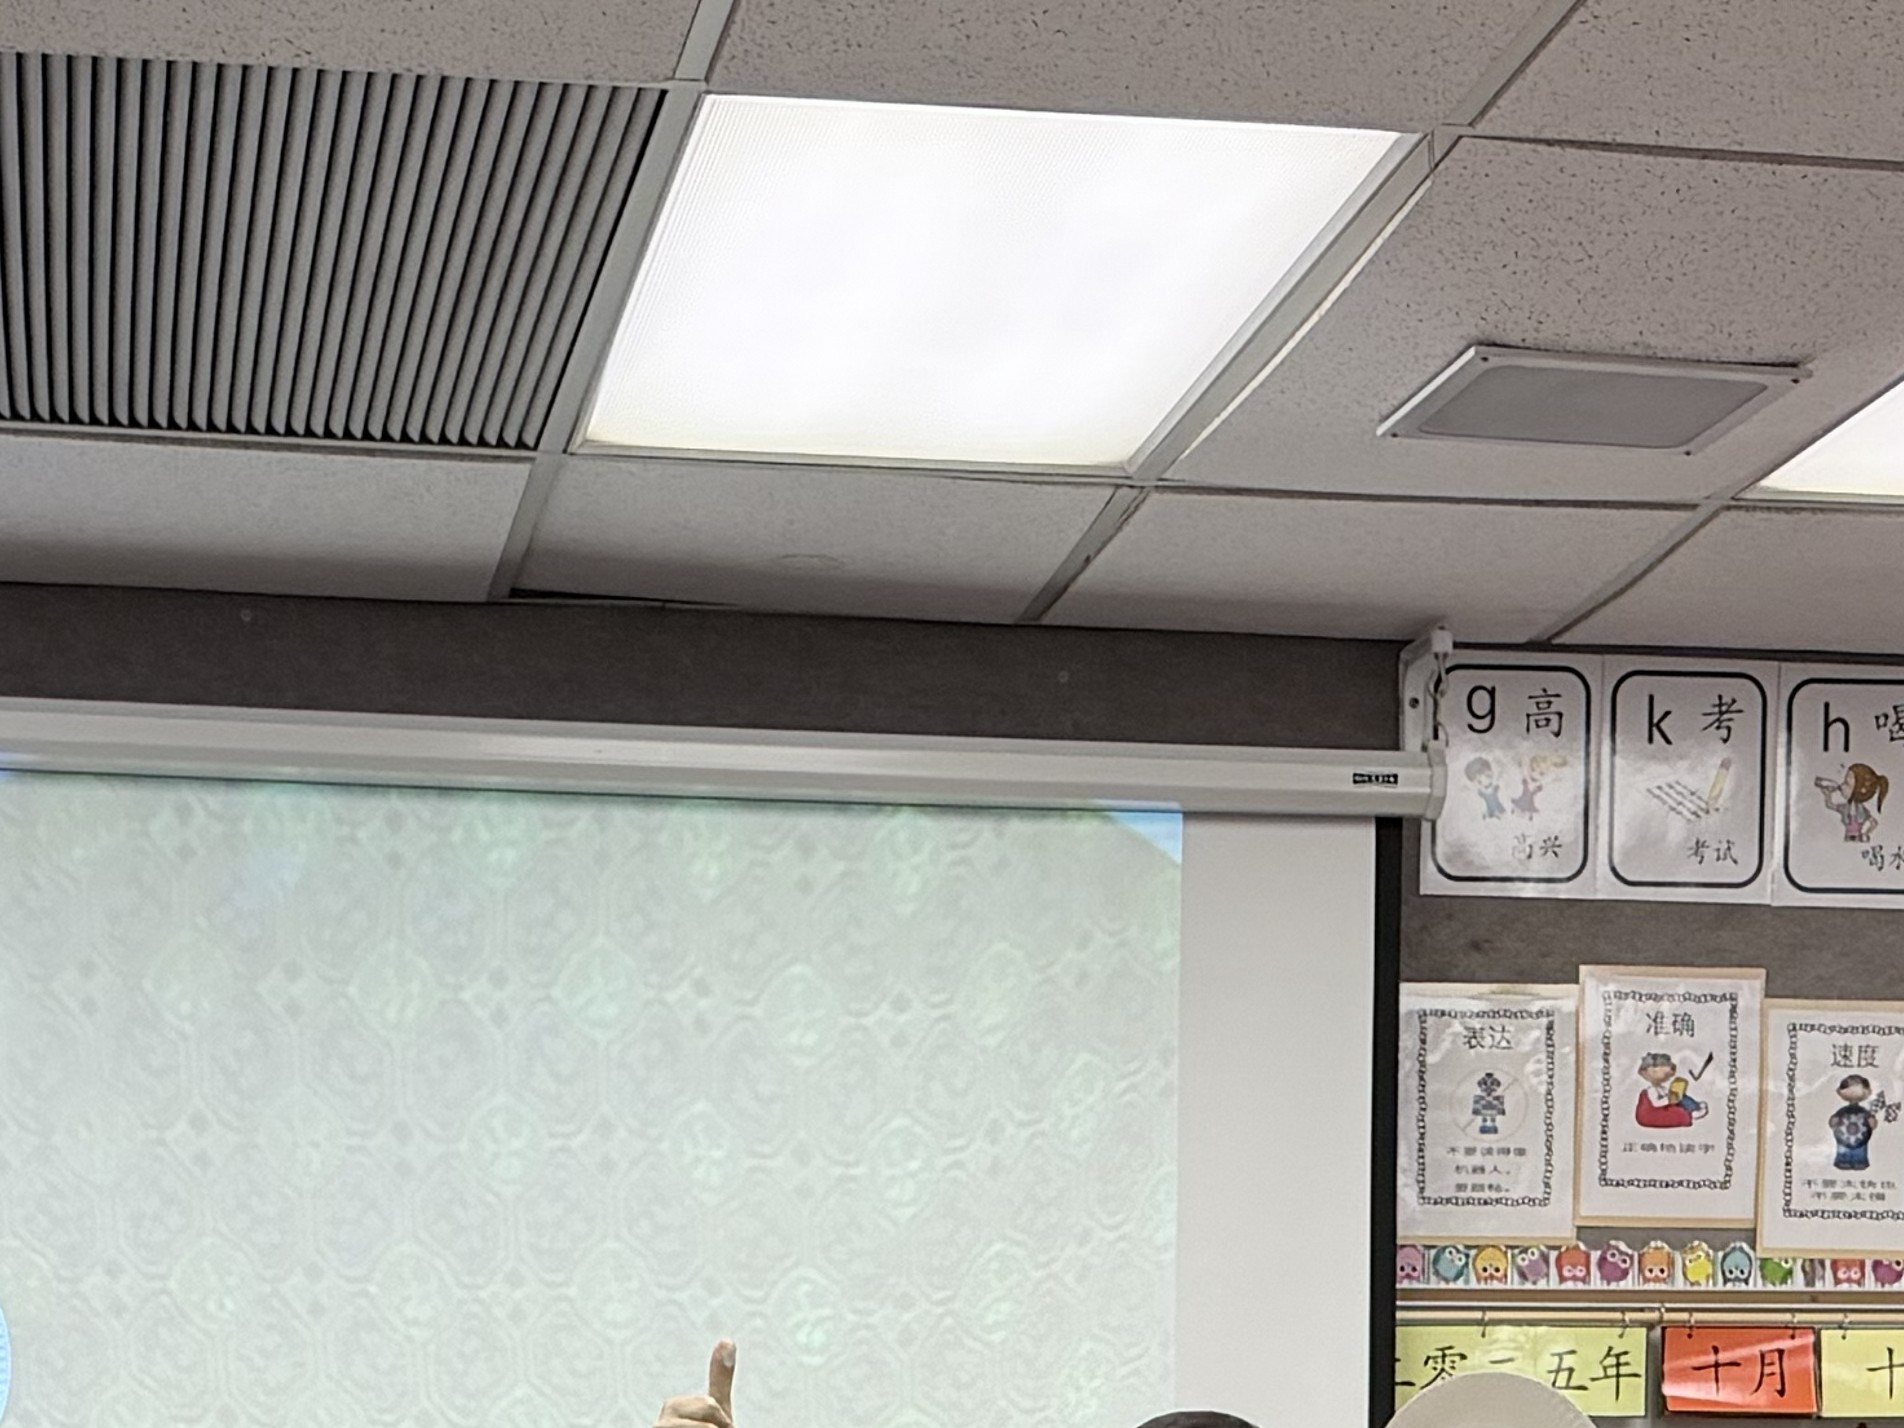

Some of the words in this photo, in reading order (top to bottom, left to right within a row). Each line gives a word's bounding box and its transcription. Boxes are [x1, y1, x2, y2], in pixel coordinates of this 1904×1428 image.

[1466, 682, 1498, 734] g
[1524, 687, 1564, 738] 高
[1647, 694, 1673, 746] k
[1700, 692, 1744, 745] 考
[1823, 701, 1850, 753] h
[1511, 834, 1563, 860] 高兴
[1687, 838, 1739, 865] 考试
[1462, 1024, 1514, 1051] 表达
[1645, 1010, 1696, 1038] 准确
[1830, 1043, 1881, 1069] 速度
[1691, 1348, 1797, 1399] 十月
